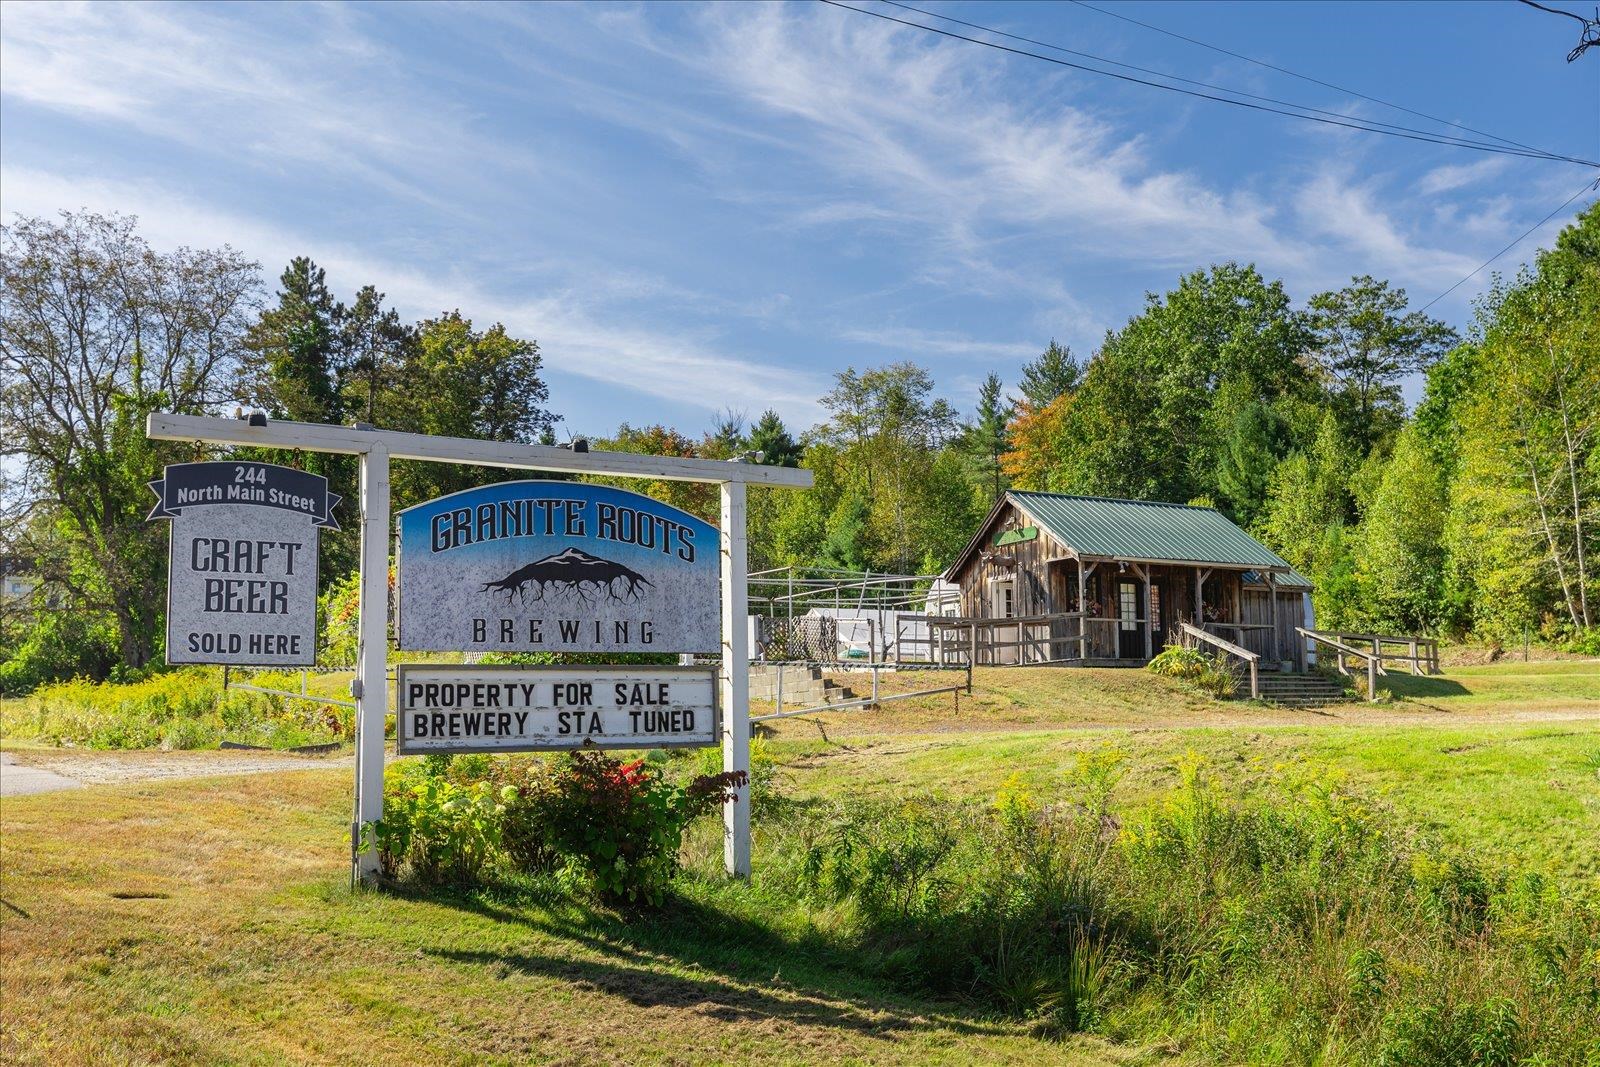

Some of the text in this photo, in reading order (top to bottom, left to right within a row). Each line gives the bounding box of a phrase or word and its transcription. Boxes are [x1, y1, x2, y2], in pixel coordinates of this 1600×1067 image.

[235, 466, 266, 485] 244
[177, 484, 315, 512] North Main Street
[430, 499, 696, 564] GRANITE ROOTS
[191, 537, 302, 575] CRAFT
[203, 578, 289, 615] BEER
[188, 632, 301, 655] SOLD HERE
[472, 618, 653, 644] BREWING
[409, 683, 669, 707] PROPERTY FOR SALE
[413, 710, 694, 737] BREWERY STA TUNED
